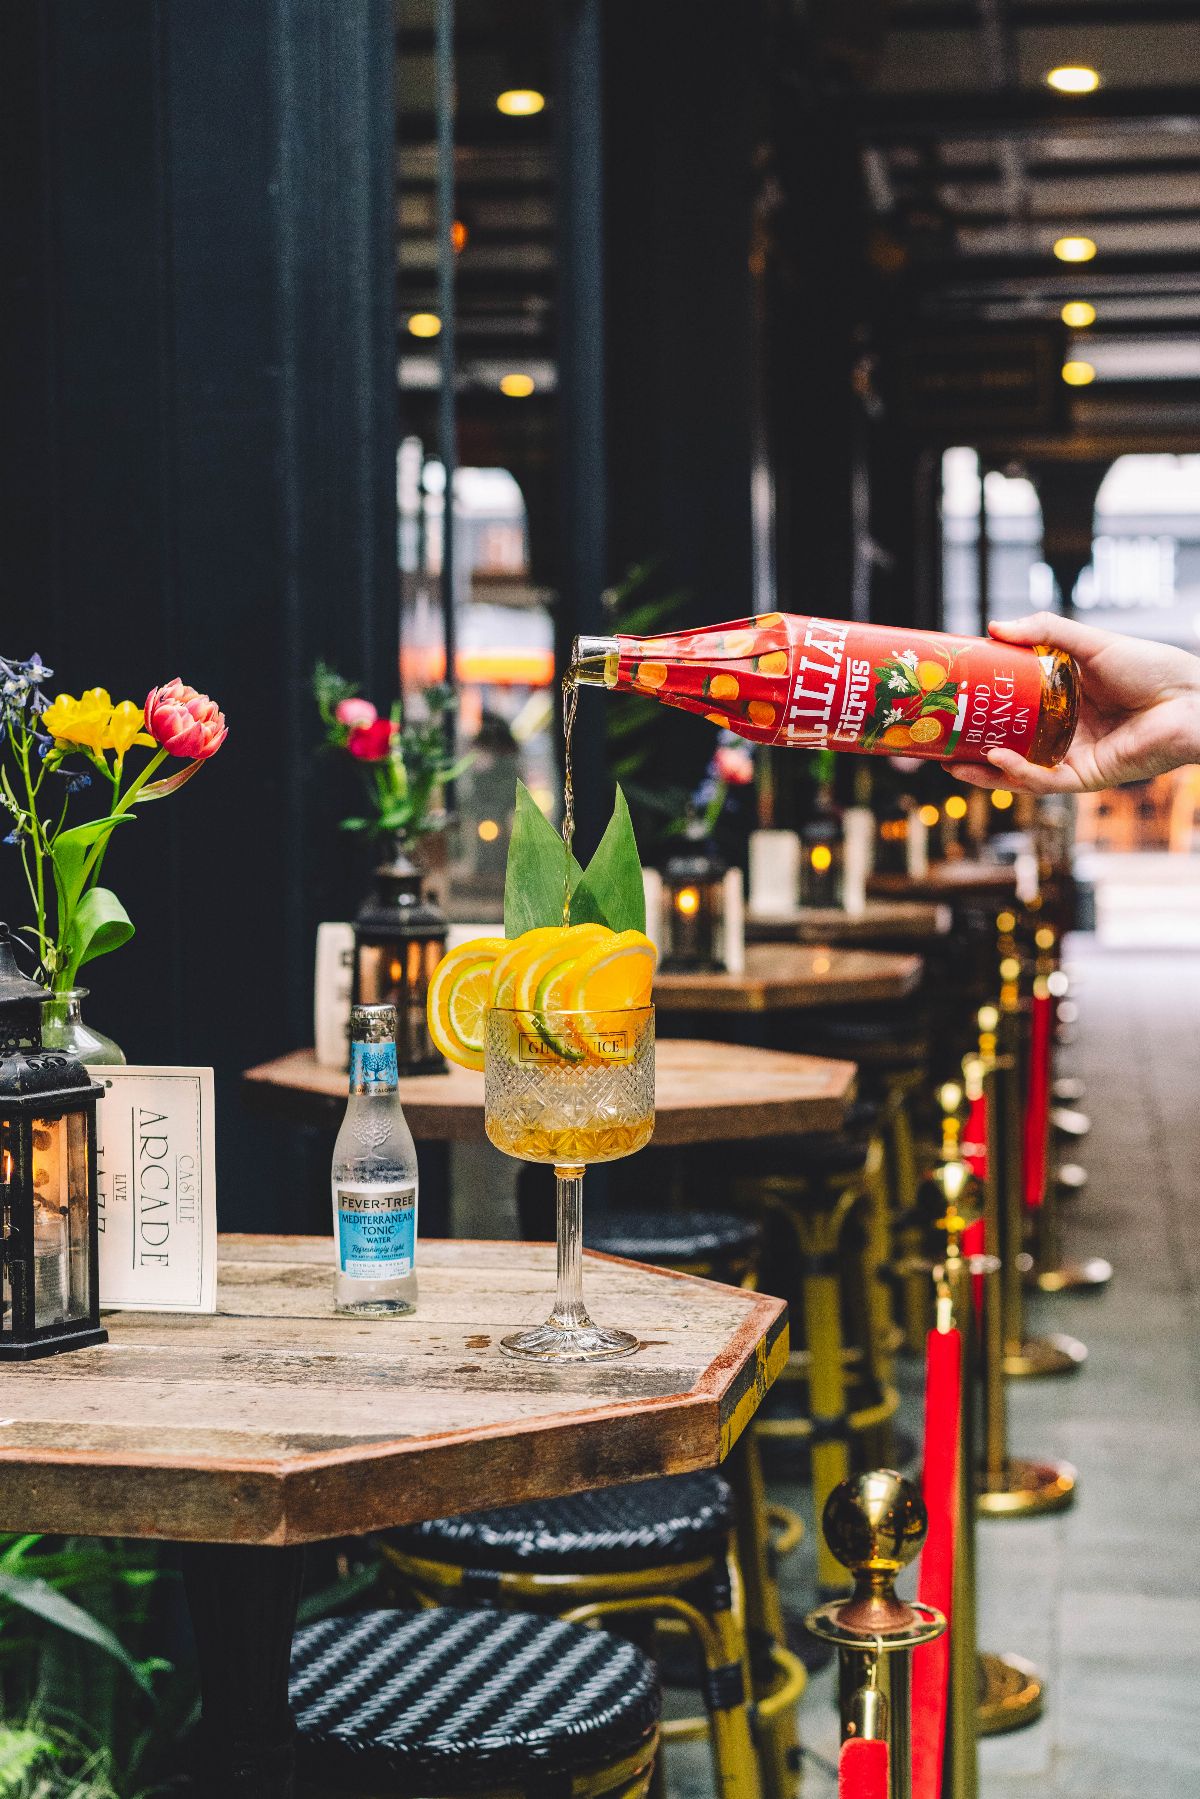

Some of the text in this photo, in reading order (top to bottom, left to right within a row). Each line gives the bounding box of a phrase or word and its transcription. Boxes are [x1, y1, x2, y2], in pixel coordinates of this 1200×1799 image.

[787, 617, 850, 750] ICILIAN
[832, 657, 870, 742] Citrus
[966, 684, 990, 743] BLOOD
[1012, 707, 1030, 734] GIN
[115, 1174, 127, 1202] LIVE
[139, 1107, 170, 1267] ARCADE
[178, 1155, 195, 1224] CASTLE
[341, 1195, 414, 1209] FEVER-TREE
[341, 1211, 413, 1225] MEDITERRANEAN
[362, 1225, 395, 1235] TONIC
[366, 1236, 391, 1244] WATER
